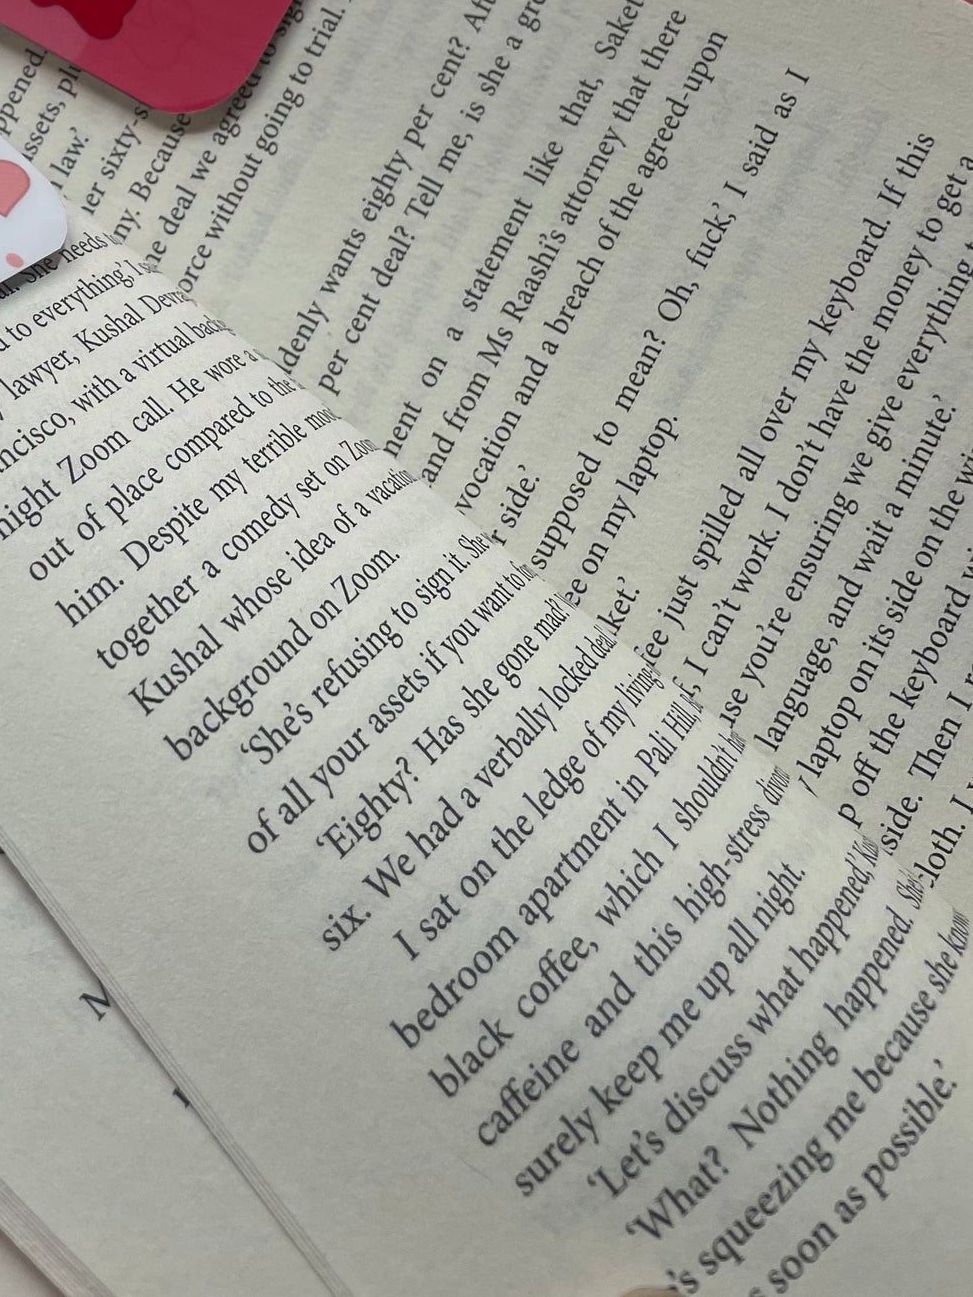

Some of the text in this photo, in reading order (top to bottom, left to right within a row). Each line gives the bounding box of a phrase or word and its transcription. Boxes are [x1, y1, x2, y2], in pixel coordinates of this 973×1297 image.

[204, 153, 263, 240] without
[255, 87, 305, 156] going
[289, 61, 313, 85] to
[304, 7, 346, 58] trial.
[319, 228, 366, 294] wants
[362, 149, 413, 222] eighty
[402, 103, 434, 151] per
[430, 36, 471, 99] cent?
[742, 123, 779, 177] said
[773, 92, 797, 120] as
[784, 67, 810, 85] I
[421, 356, 448, 388] on
[446, 326, 464, 342] a
[462, 197, 534, 313] statement
[522, 141, 564, 187] like
[559, 78, 604, 127] that,
[442, 372, 491, 433] from
[476, 326, 514, 369] Ms
[560, 125, 627, 226] attorney
[612, 74, 652, 123] that
[640, 10, 687, 71] there
[514, 31, 729, 406] and a breach of the agreed-upon
[722, 180, 748, 199] I
[4, 322, 33, 342] to
[70, 374, 123, 413] with
[119, 367, 138, 383] a
[131, 324, 197, 374] virtual
[71, 302, 147, 354] Kushal
[614, 329, 666, 414] mean?
[657, 282, 700, 322] Oh,
[657, 133, 935, 631] just spilled all over my keyboard. If this
[29, 375, 298, 582] out of place compared to the
[55, 430, 132, 485] Zoom
[132, 395, 175, 433] call.
[166, 377, 206, 405] He
[202, 353, 247, 383] wore
[530, 450, 602, 571] supposed
[592, 420, 619, 447] to
[54, 422, 308, 629] him. Despite my terrible
[96, 453, 352, 670] together a comedy set on
[127, 500, 373, 717] Kushal whose idea of a
[753, 637, 839, 753] language,
[827, 573, 864, 629] and
[852, 519, 894, 573] wait
[885, 502, 905, 519] a
[162, 549, 401, 762] background on Zoom.
[411, 714, 465, 766] Has
[460, 678, 500, 719] she
[496, 634, 540, 689] gone
[532, 596, 571, 641] mad?
[322, 644, 600, 952] six. We had a verbally locked
[392, 699, 637, 962] I sat on the ledge of my
[478, 803, 771, 1147] caffeine and this high-stress
[515, 861, 806, 1198] surely keep me up all night.
[766, 1219, 840, 1295] soon
[834, 1186, 867, 1225] as
